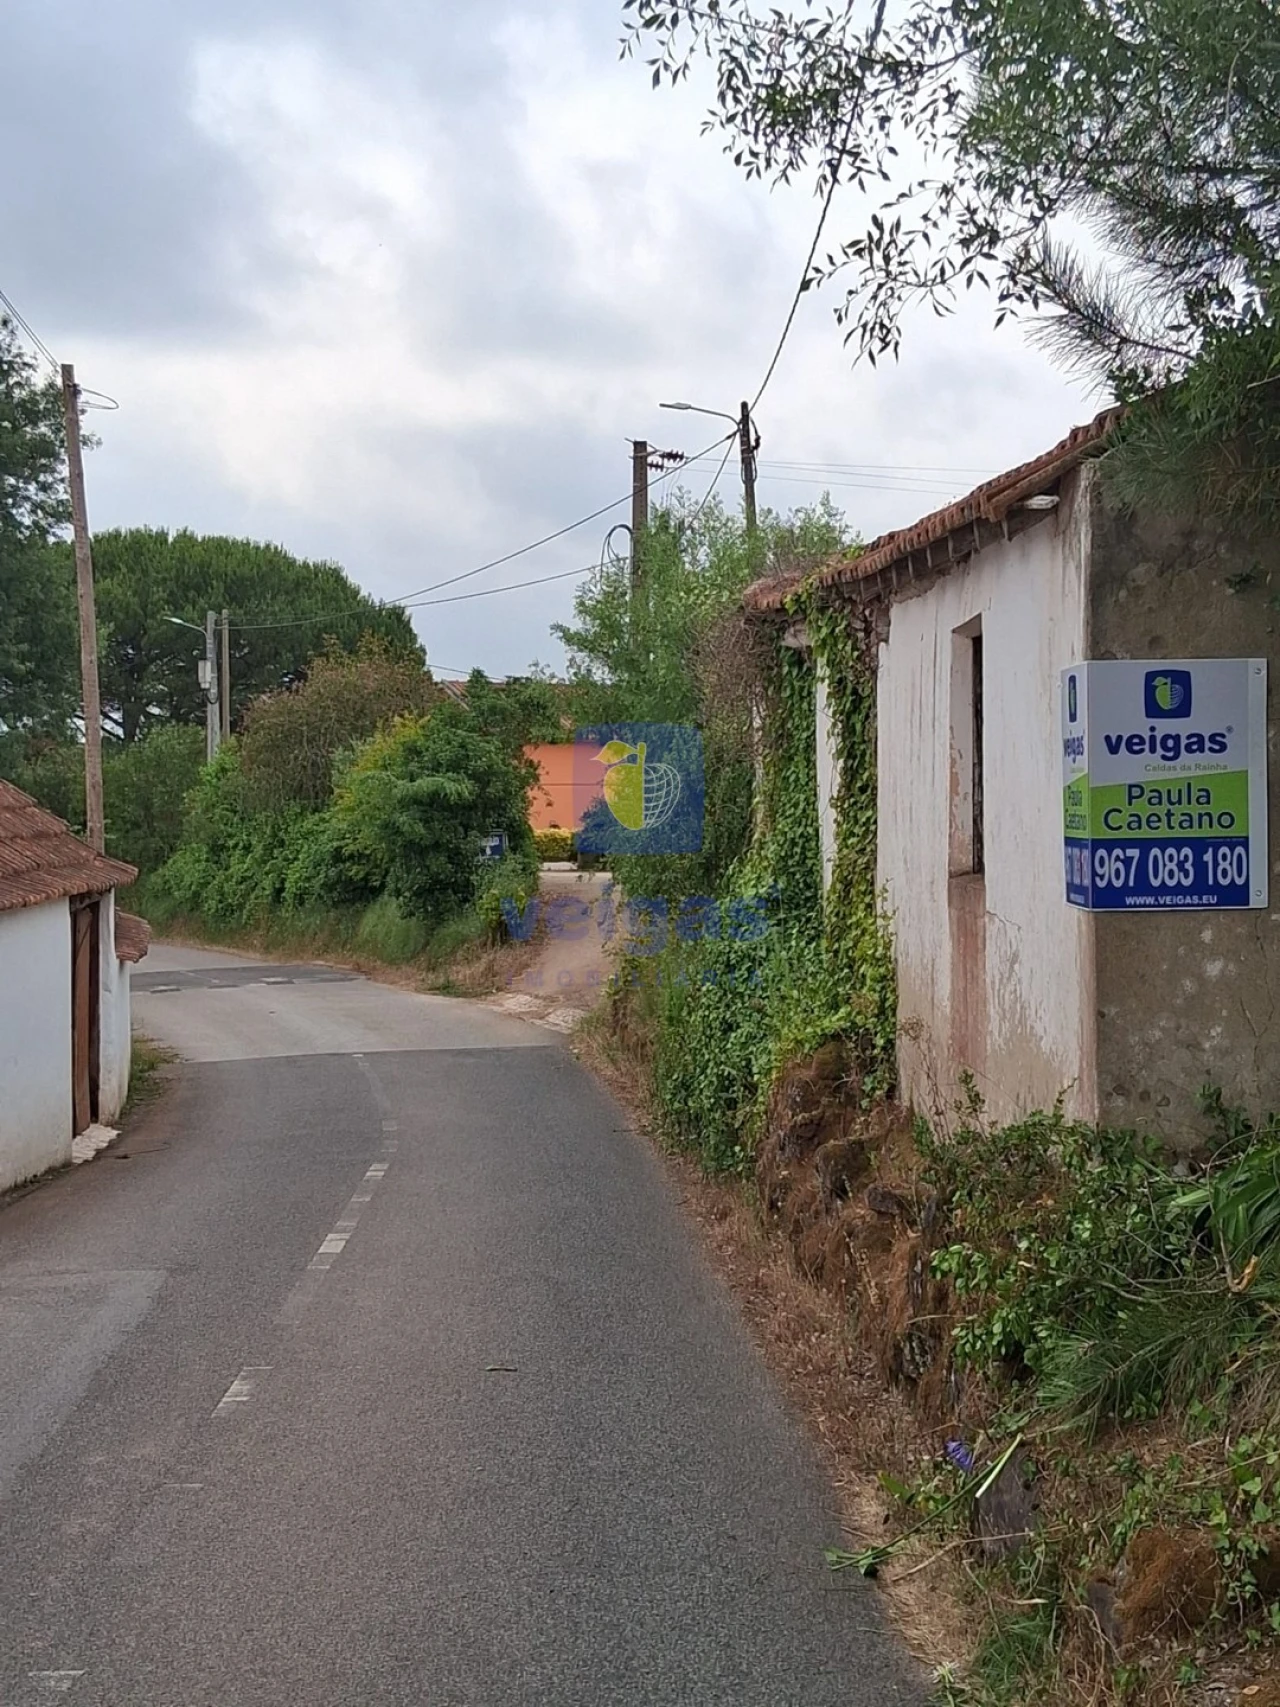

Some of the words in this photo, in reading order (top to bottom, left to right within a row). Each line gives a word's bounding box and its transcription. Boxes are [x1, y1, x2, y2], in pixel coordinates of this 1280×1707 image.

[1103, 726, 1229, 761] veigas
[1144, 764, 1178, 772] Caldas
[1180, 764, 1192, 772] da
[1194, 762, 1229, 771] Rainha
[1127, 782, 1212, 807] Paula
[1103, 807, 1236, 832] Caetano
[1094, 848, 1140, 888] 967
[1148, 847, 1195, 888] 083
[1202, 846, 1248, 886] 180
[1125, 895, 1217, 906] WWW.VEIGAS.EU
